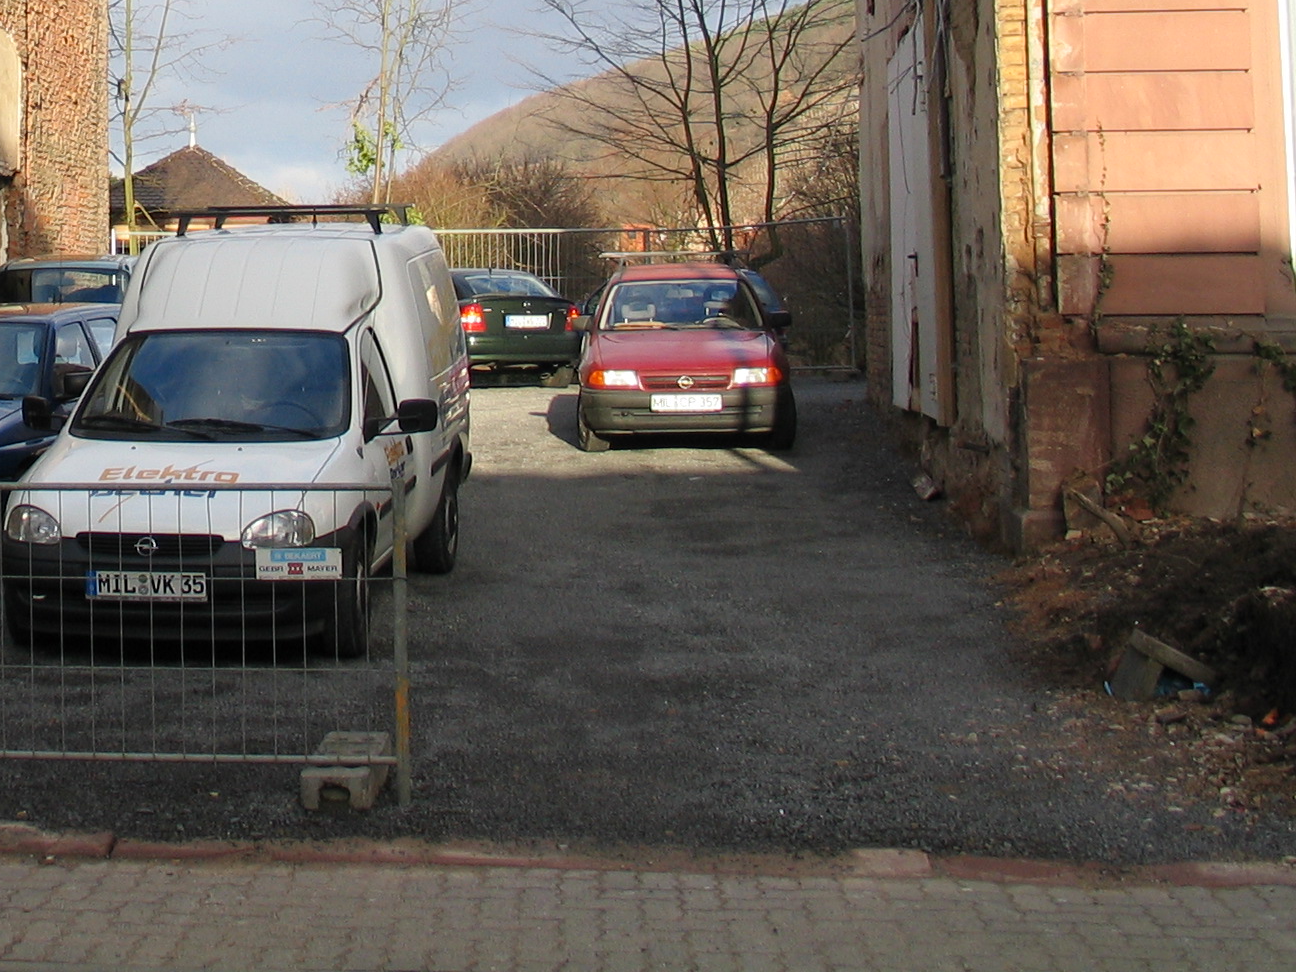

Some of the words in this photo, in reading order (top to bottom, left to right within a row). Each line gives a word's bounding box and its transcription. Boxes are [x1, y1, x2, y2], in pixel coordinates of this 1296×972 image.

[98, 464, 241, 484] Elektro
[98, 573, 137, 594] MIL
[150, 574, 175, 595] VK
[181, 574, 205, 595] 35
